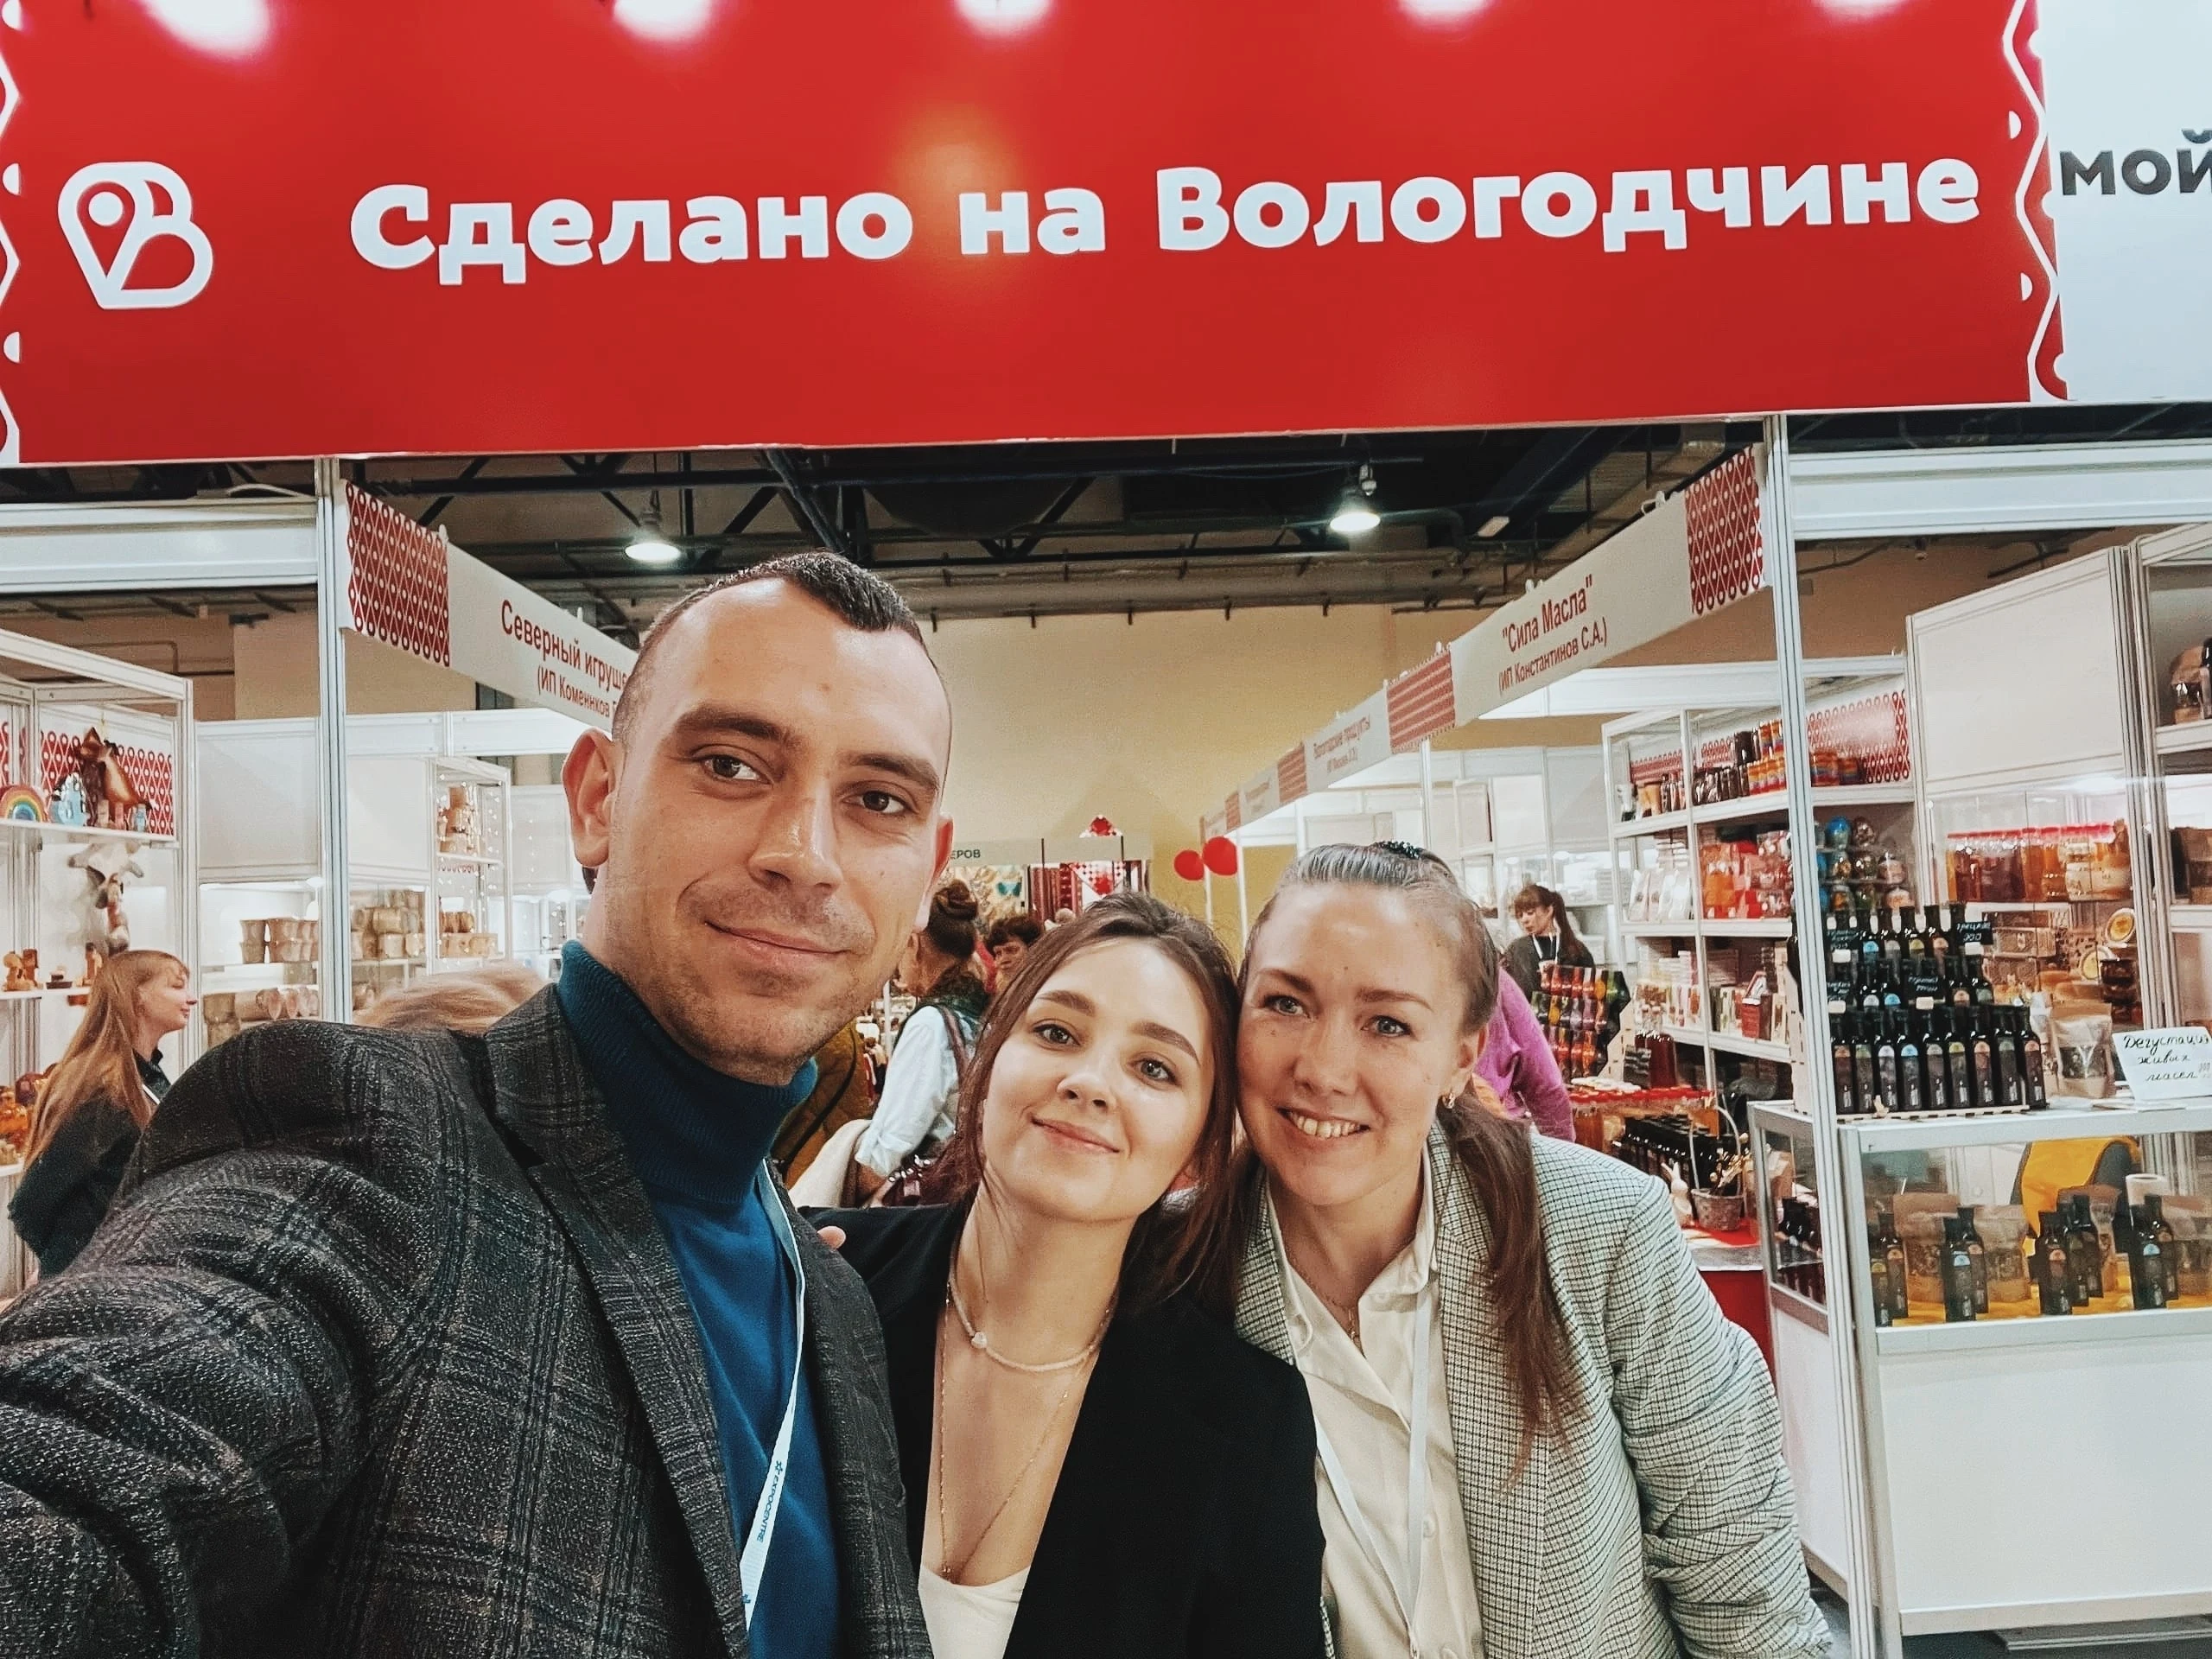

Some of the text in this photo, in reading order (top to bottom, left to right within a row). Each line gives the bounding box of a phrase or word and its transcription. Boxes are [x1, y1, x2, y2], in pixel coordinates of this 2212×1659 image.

[2059, 128, 2212, 195] мой
[350, 158, 1980, 285] Сделано на Вологодчине
[501, 600, 581, 671] Северный
[1502, 574, 1592, 653] "Сила Масла"
[537, 664, 556, 696] (ИП
[1515, 638, 1579, 684] Константинов
[1581, 616, 1607, 651] С.А.)
[757, 1474, 779, 1543] EXPOCENTRE
